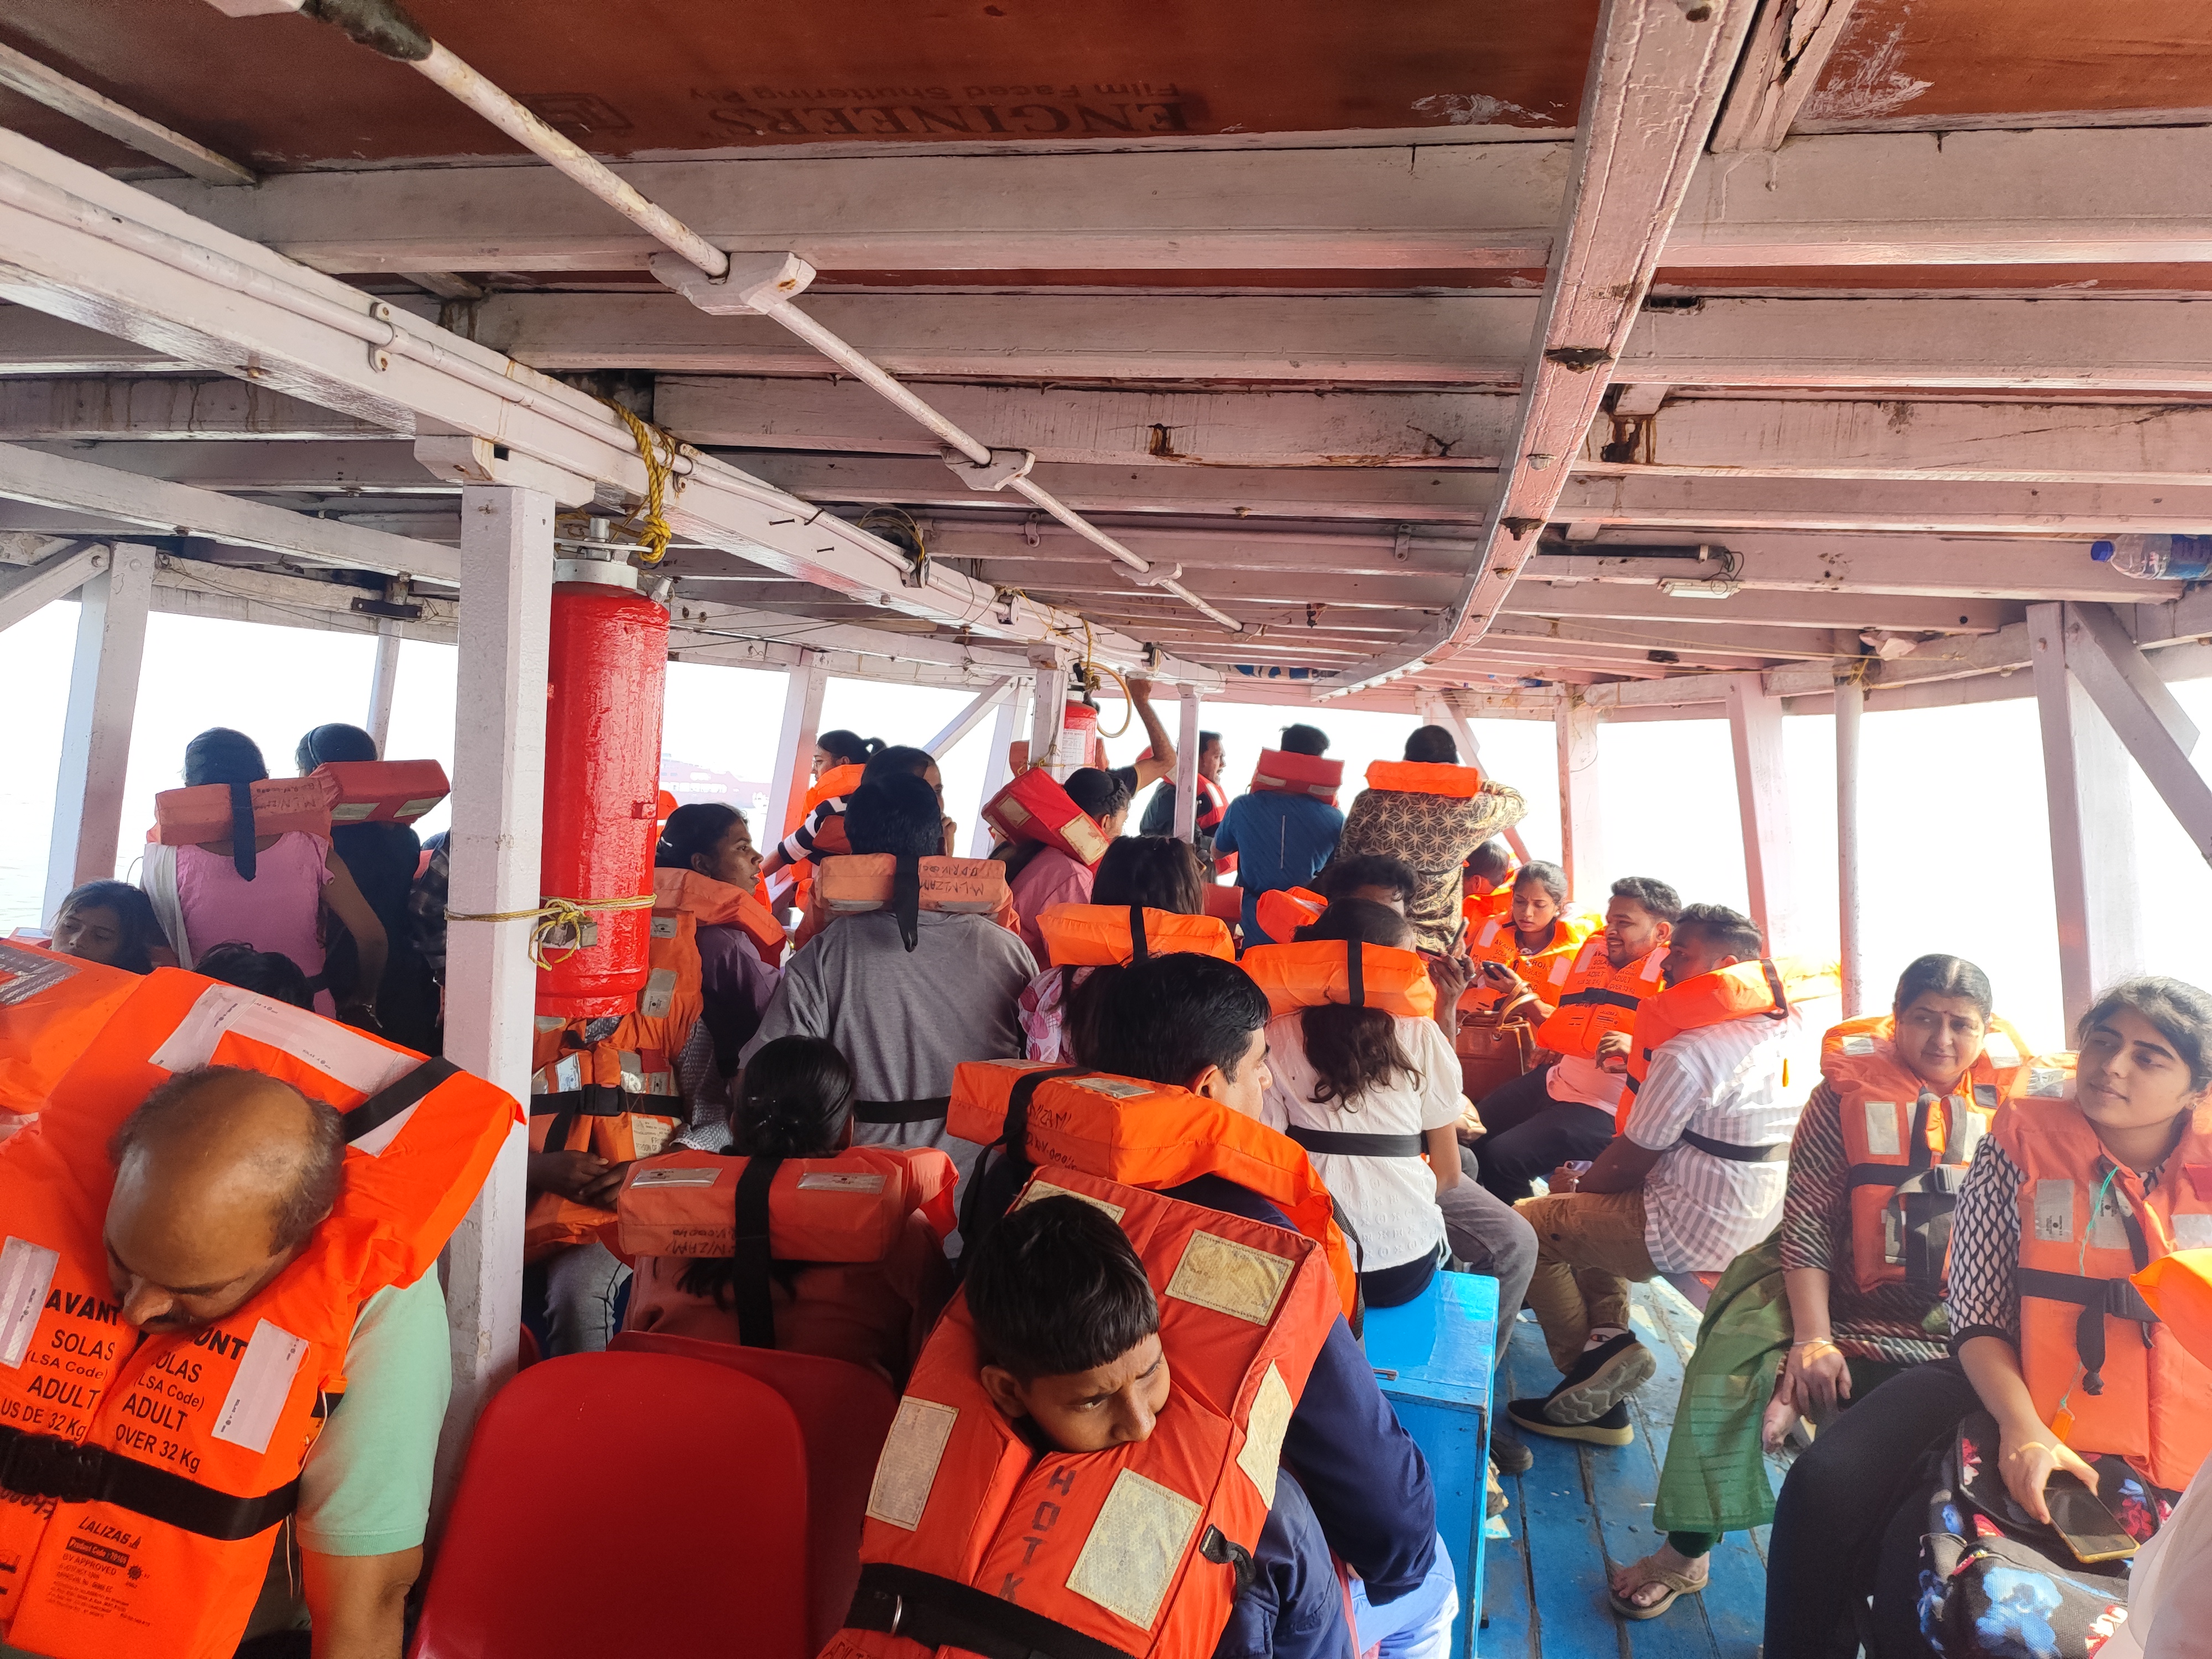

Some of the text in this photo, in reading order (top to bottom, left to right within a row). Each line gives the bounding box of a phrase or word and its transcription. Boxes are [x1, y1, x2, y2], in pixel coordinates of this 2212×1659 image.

[753, 84, 952, 104] Shuttering
[966, 84, 1081, 100] Faced
[1095, 82, 1178, 100] Film
[709, 101, 1188, 136] ENGINEERS
[45, 1289, 123, 1326] AVANT
[51, 1329, 116, 1361] SOLAS
[192, 1327, 249, 1360] ONT
[25, 1350, 108, 1382] (LSA Code)
[150, 1352, 202, 1383] OLAS
[27, 1375, 101, 1410] ADULT
[167, 1385, 205, 1412] Code)
[1, 1397, 87, 1442] US DE 32 Kg
[121, 1393, 188, 1432] ADULT
[115, 1423, 201, 1475] OVER 32 Kg
[78, 1516, 132, 1545] LALIZAS
